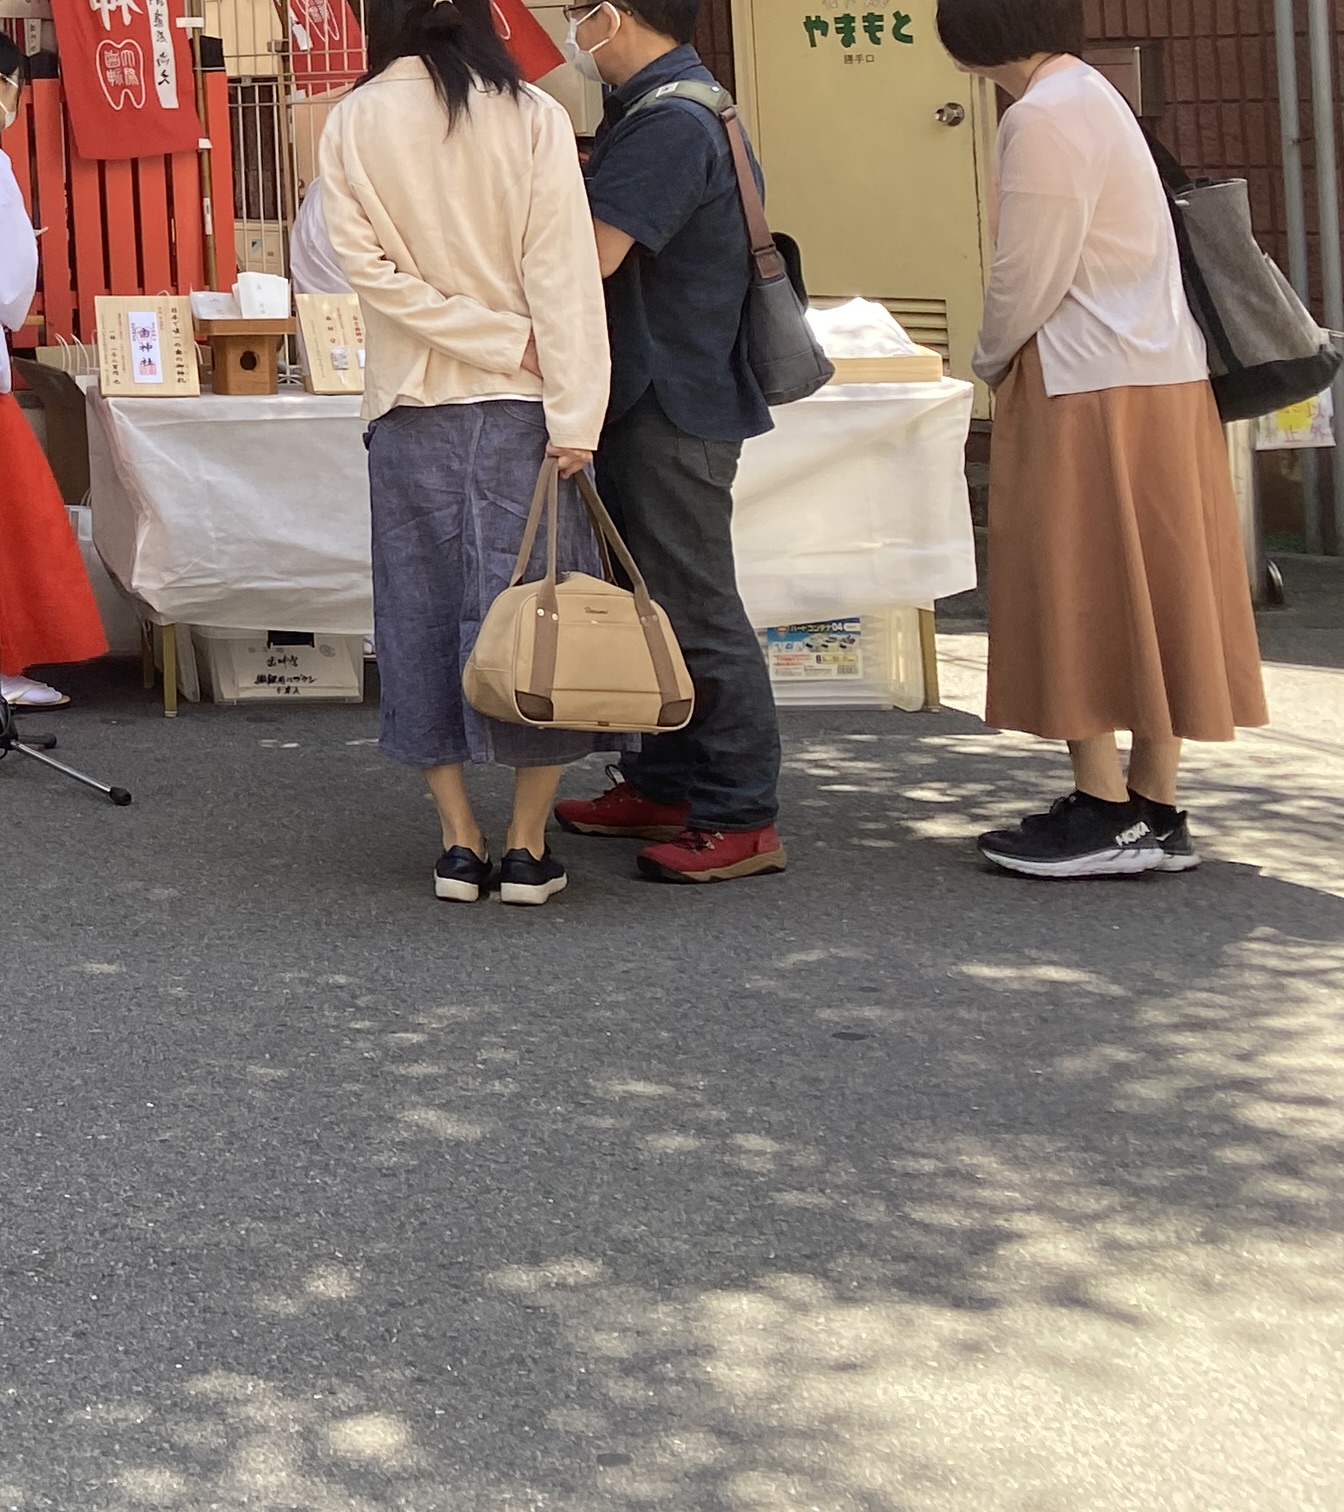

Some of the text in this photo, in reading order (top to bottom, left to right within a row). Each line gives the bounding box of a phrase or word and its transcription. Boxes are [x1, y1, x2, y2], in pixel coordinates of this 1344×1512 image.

[802, 9, 915, 49] やまもと
[1115, 821, 1151, 848] HOKA
